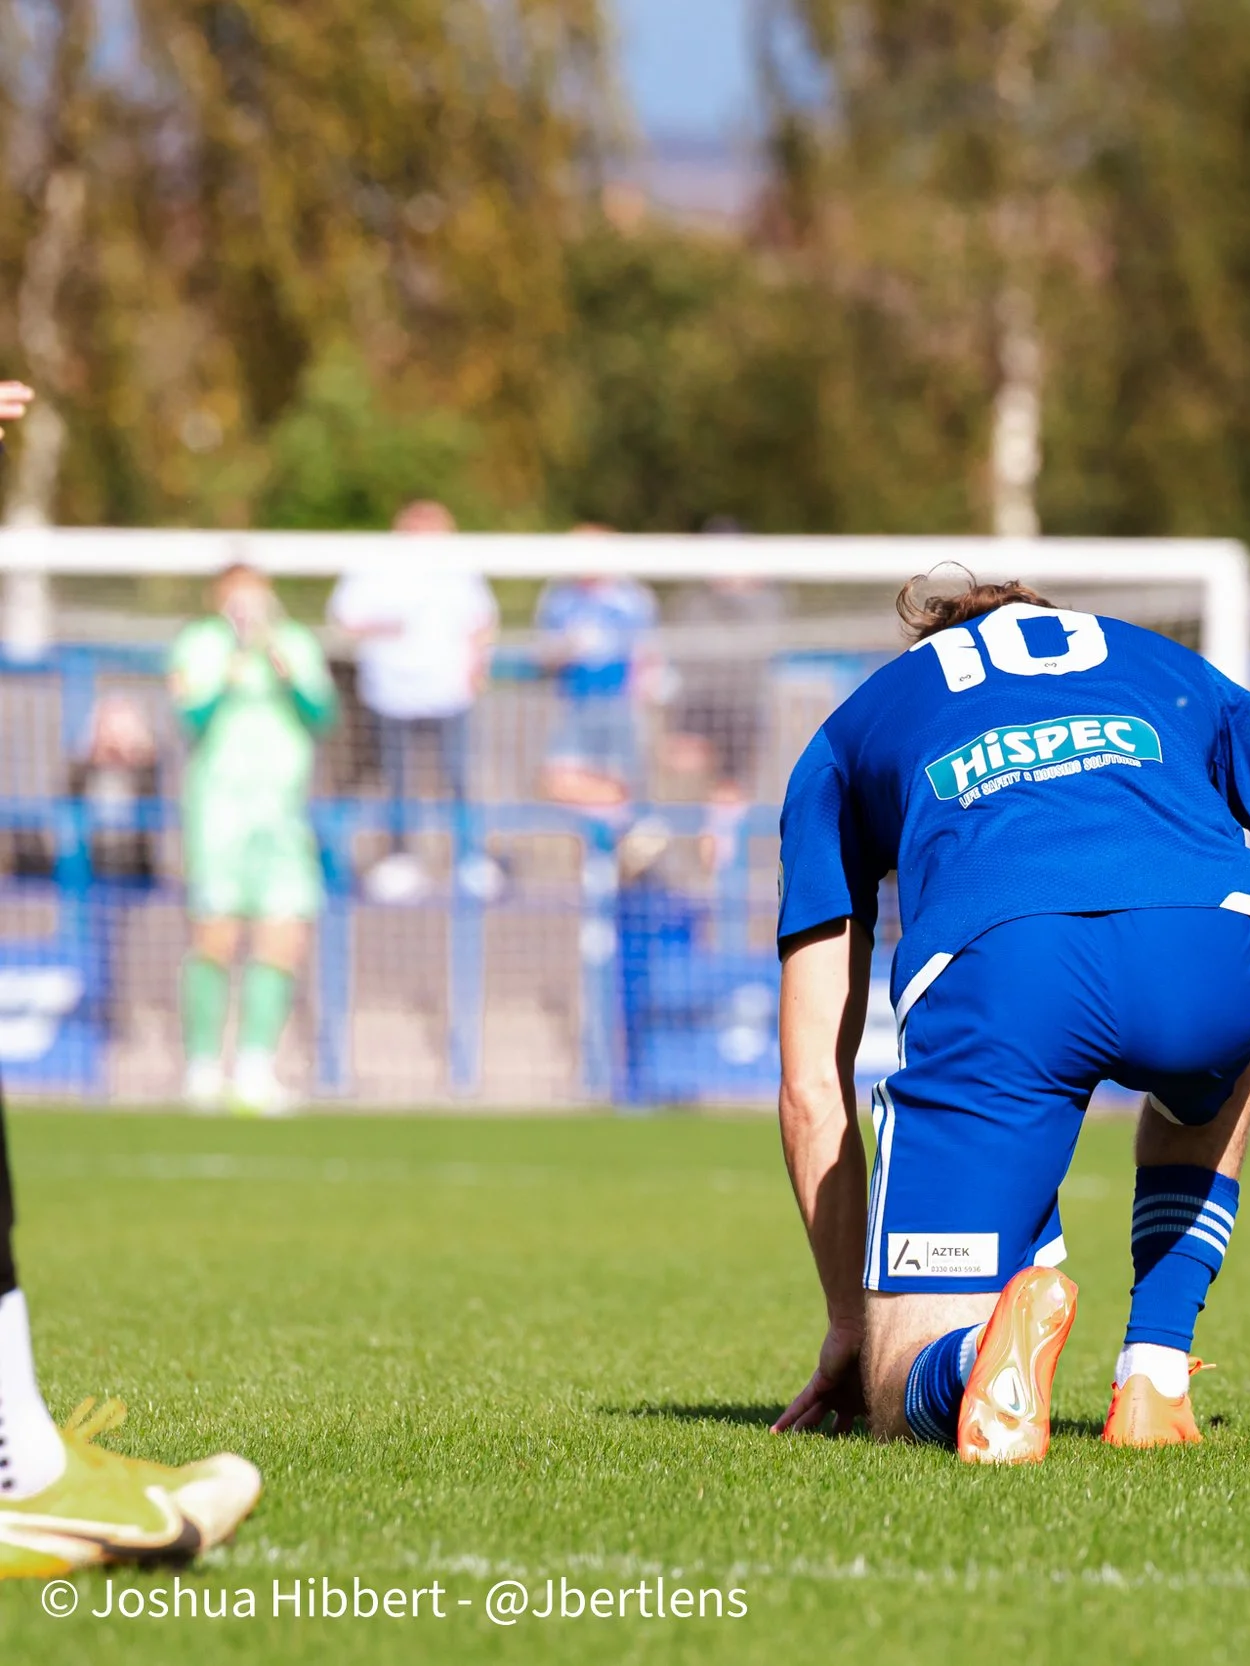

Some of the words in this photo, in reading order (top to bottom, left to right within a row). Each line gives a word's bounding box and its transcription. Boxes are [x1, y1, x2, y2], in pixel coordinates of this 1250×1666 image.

[909, 602, 1108, 693] 10
[959, 789, 981, 809] LIFE
[982, 771, 1021, 796] SAFETY
[1023, 771, 1033, 782] &
[1033, 760, 1082, 782] HOUSING
[931, 1248, 970, 1256] AZTEK
